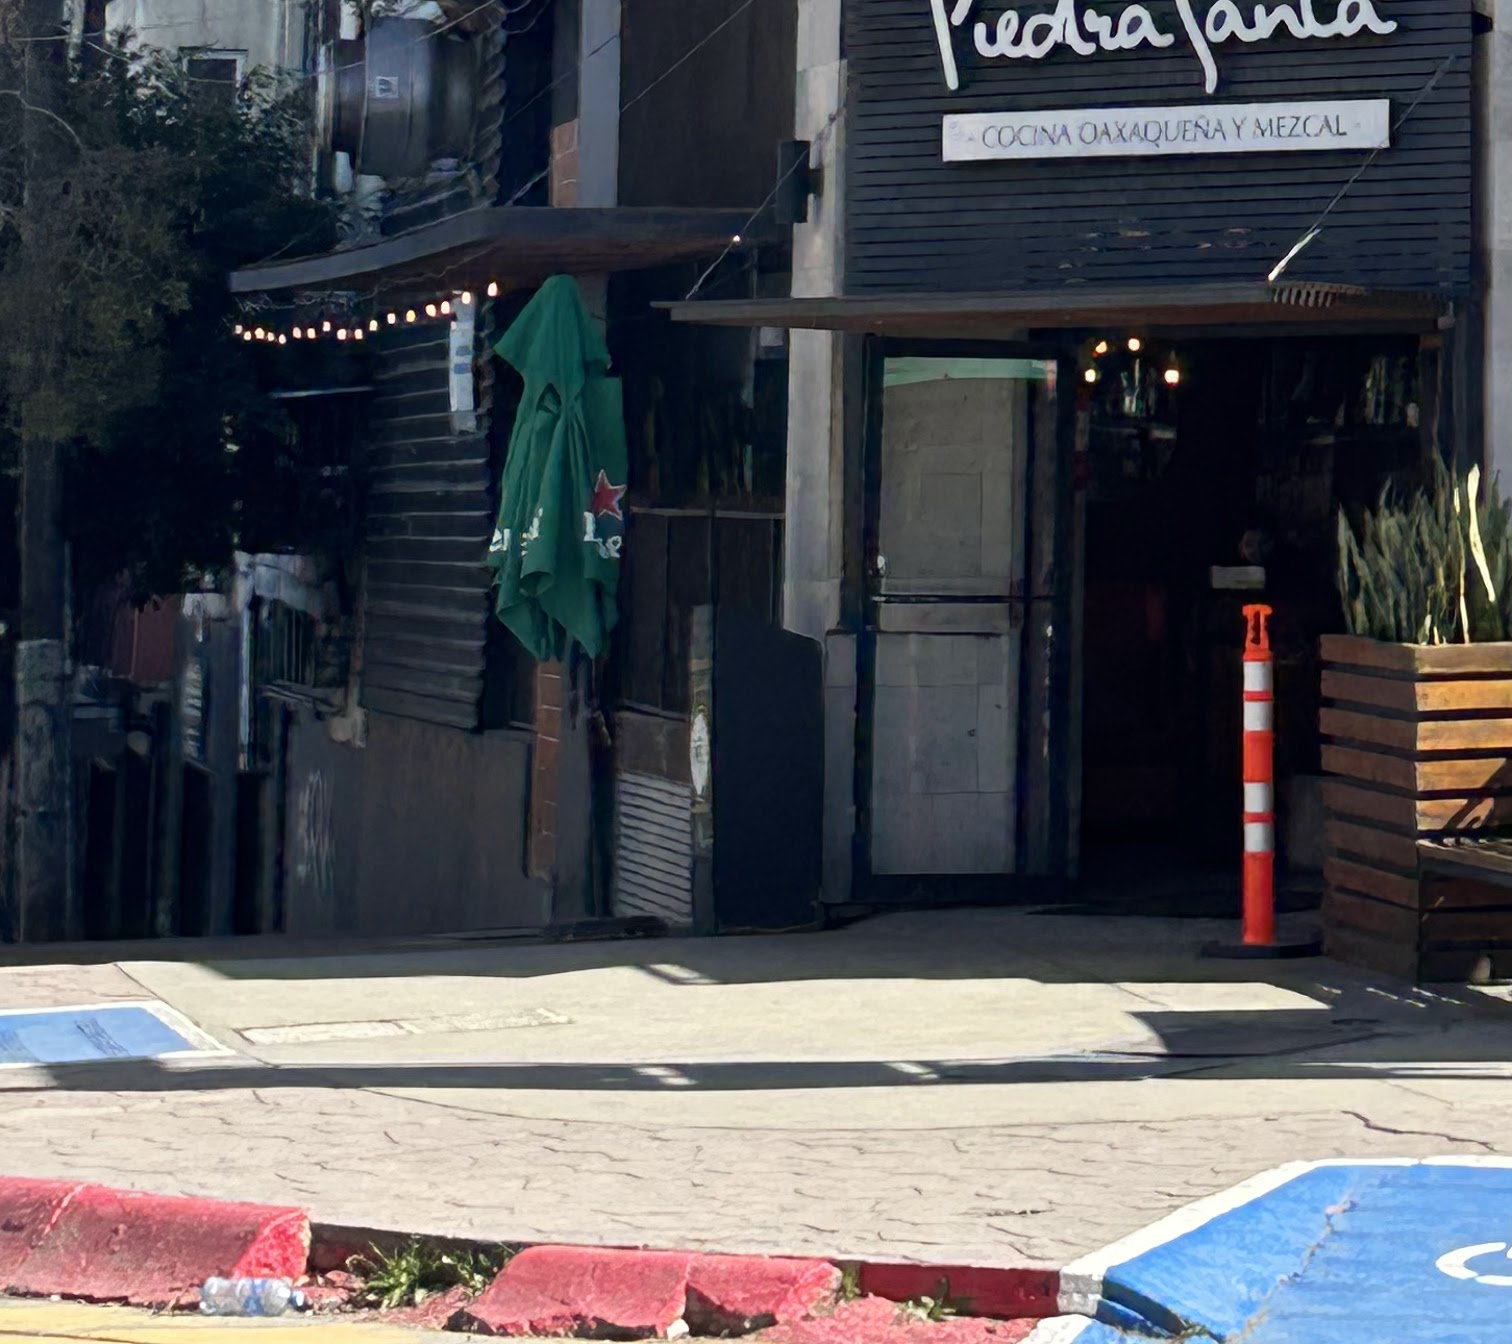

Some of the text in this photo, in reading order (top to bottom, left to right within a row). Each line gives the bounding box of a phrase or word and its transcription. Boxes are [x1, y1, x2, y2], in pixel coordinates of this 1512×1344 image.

[981, 114, 1348, 149] COCINA OAXAQUEÑA Y MEZCAL
